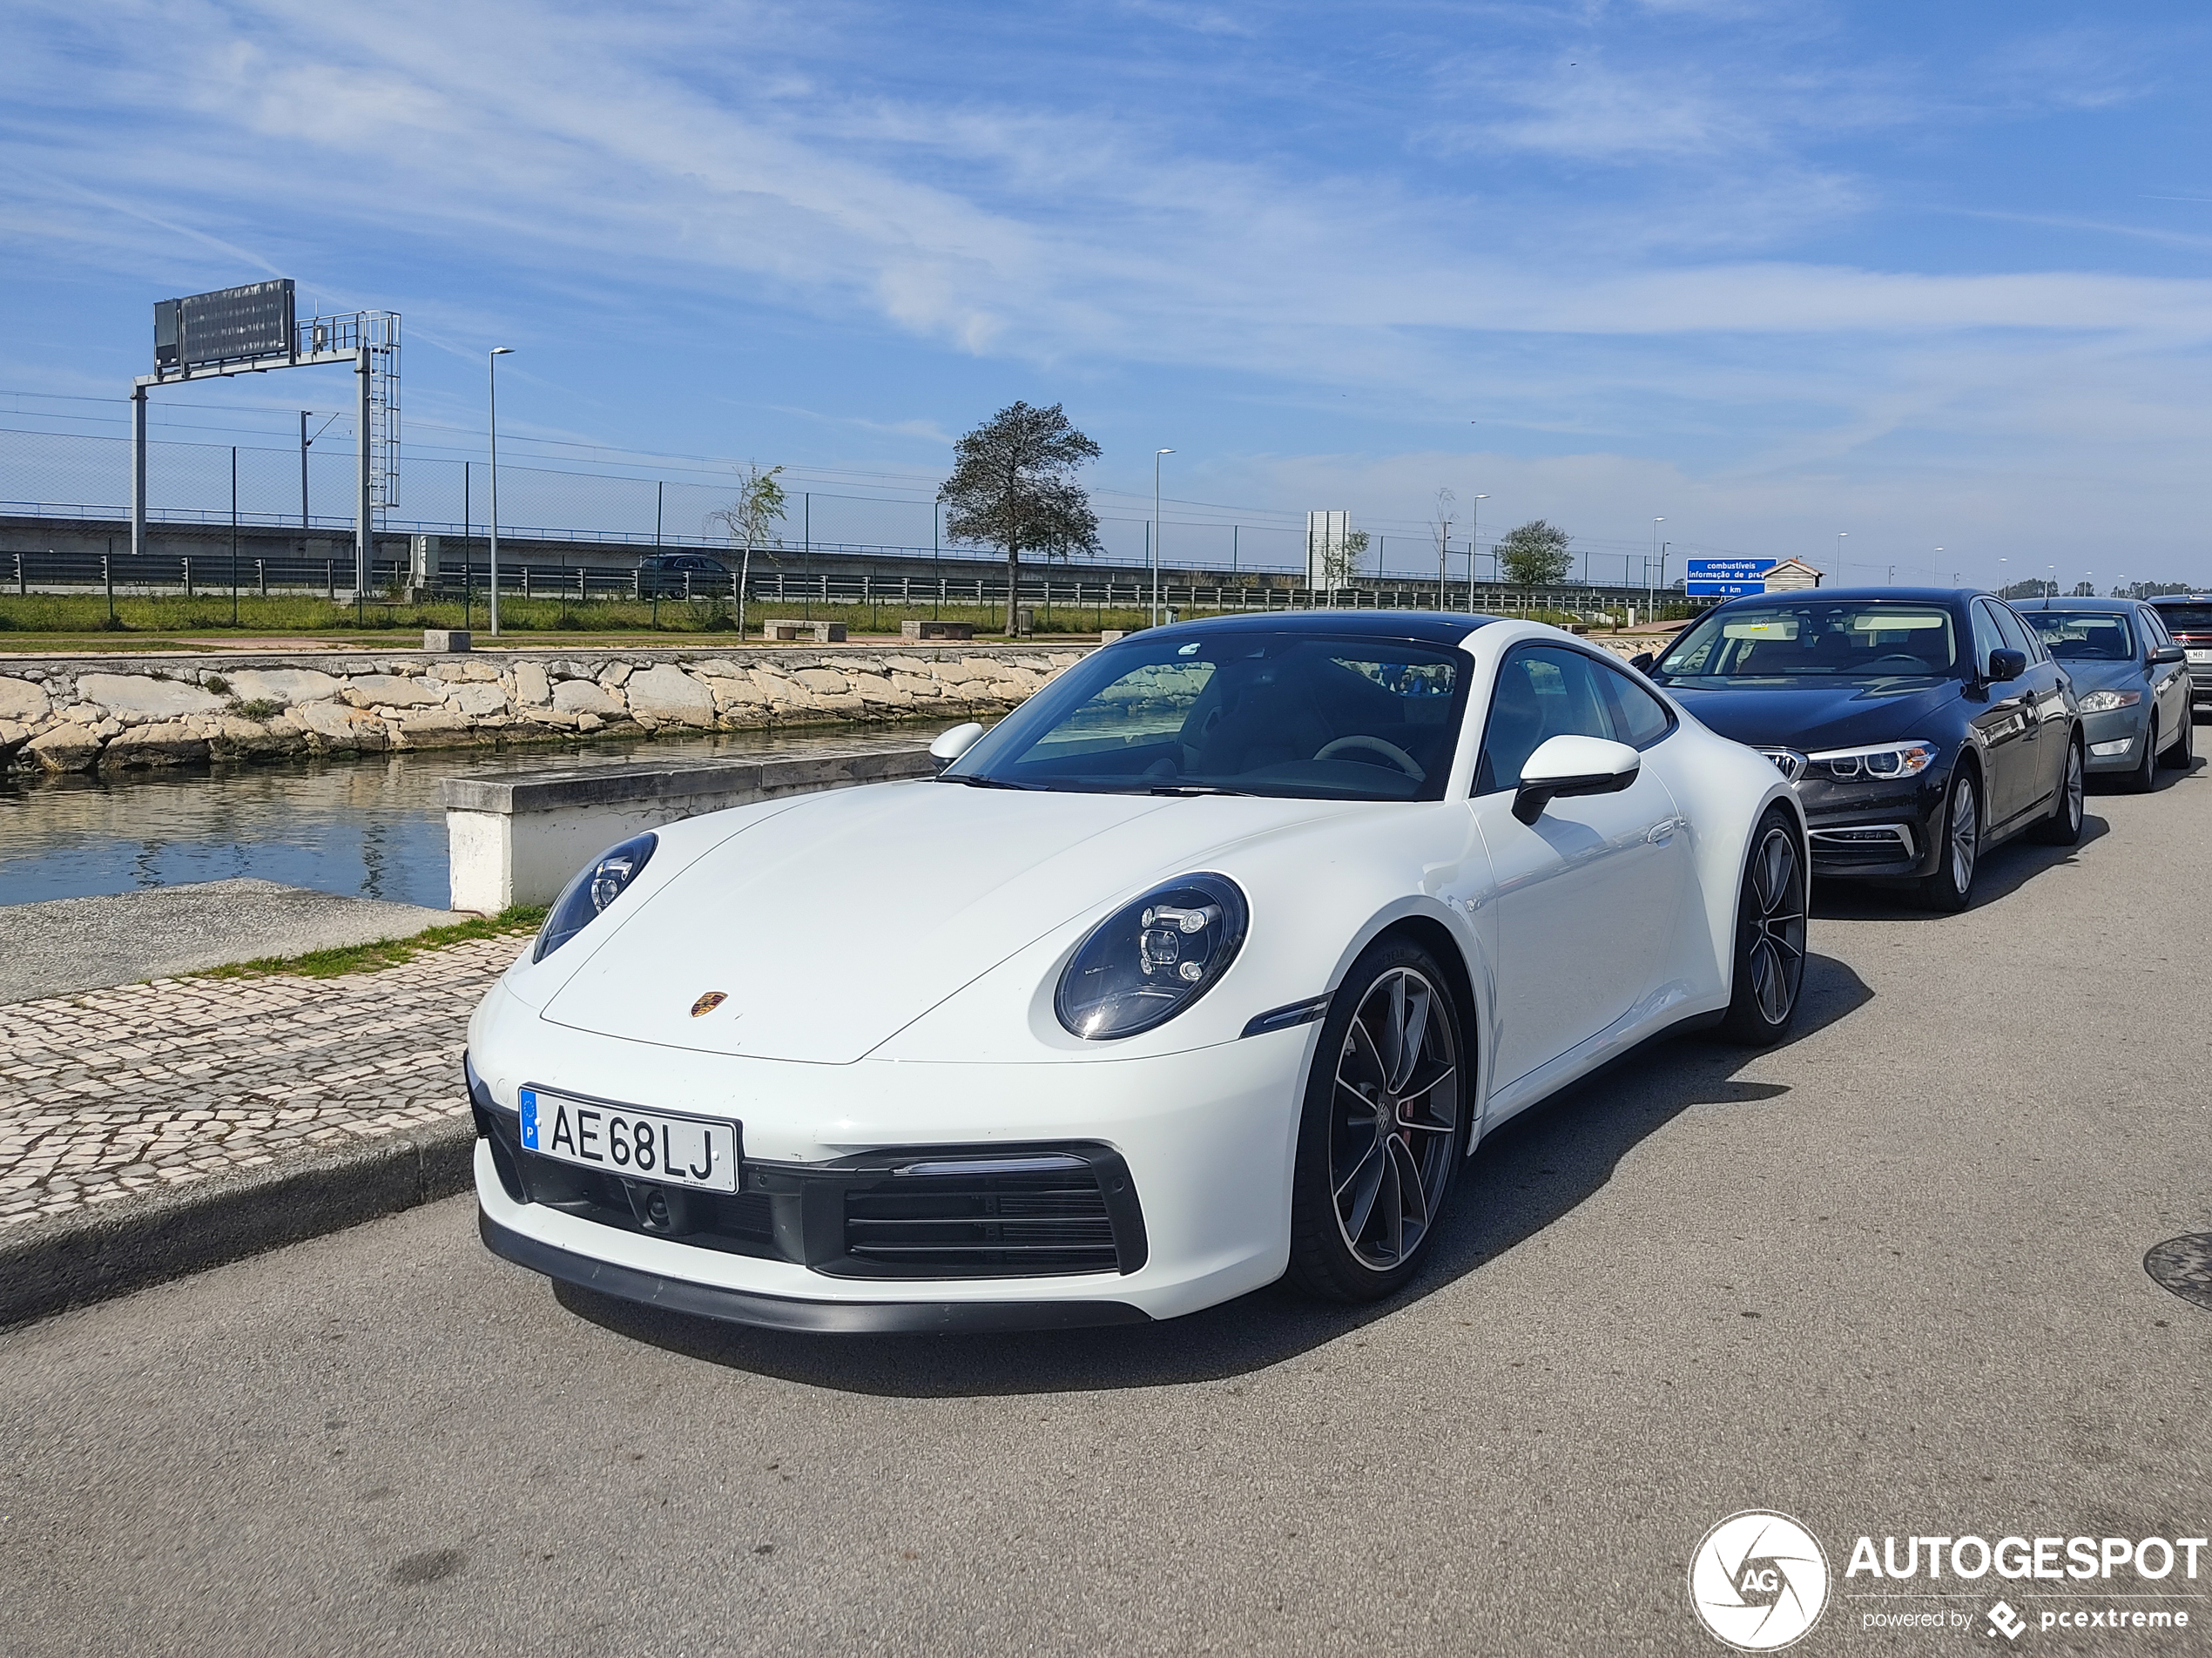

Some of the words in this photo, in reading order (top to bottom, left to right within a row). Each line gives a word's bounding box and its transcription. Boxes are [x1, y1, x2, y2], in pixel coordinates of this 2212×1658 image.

[1689, 570, 1730, 580] informação
[526, 1126, 534, 1139] P
[551, 1104, 712, 1180] AE68LJ
